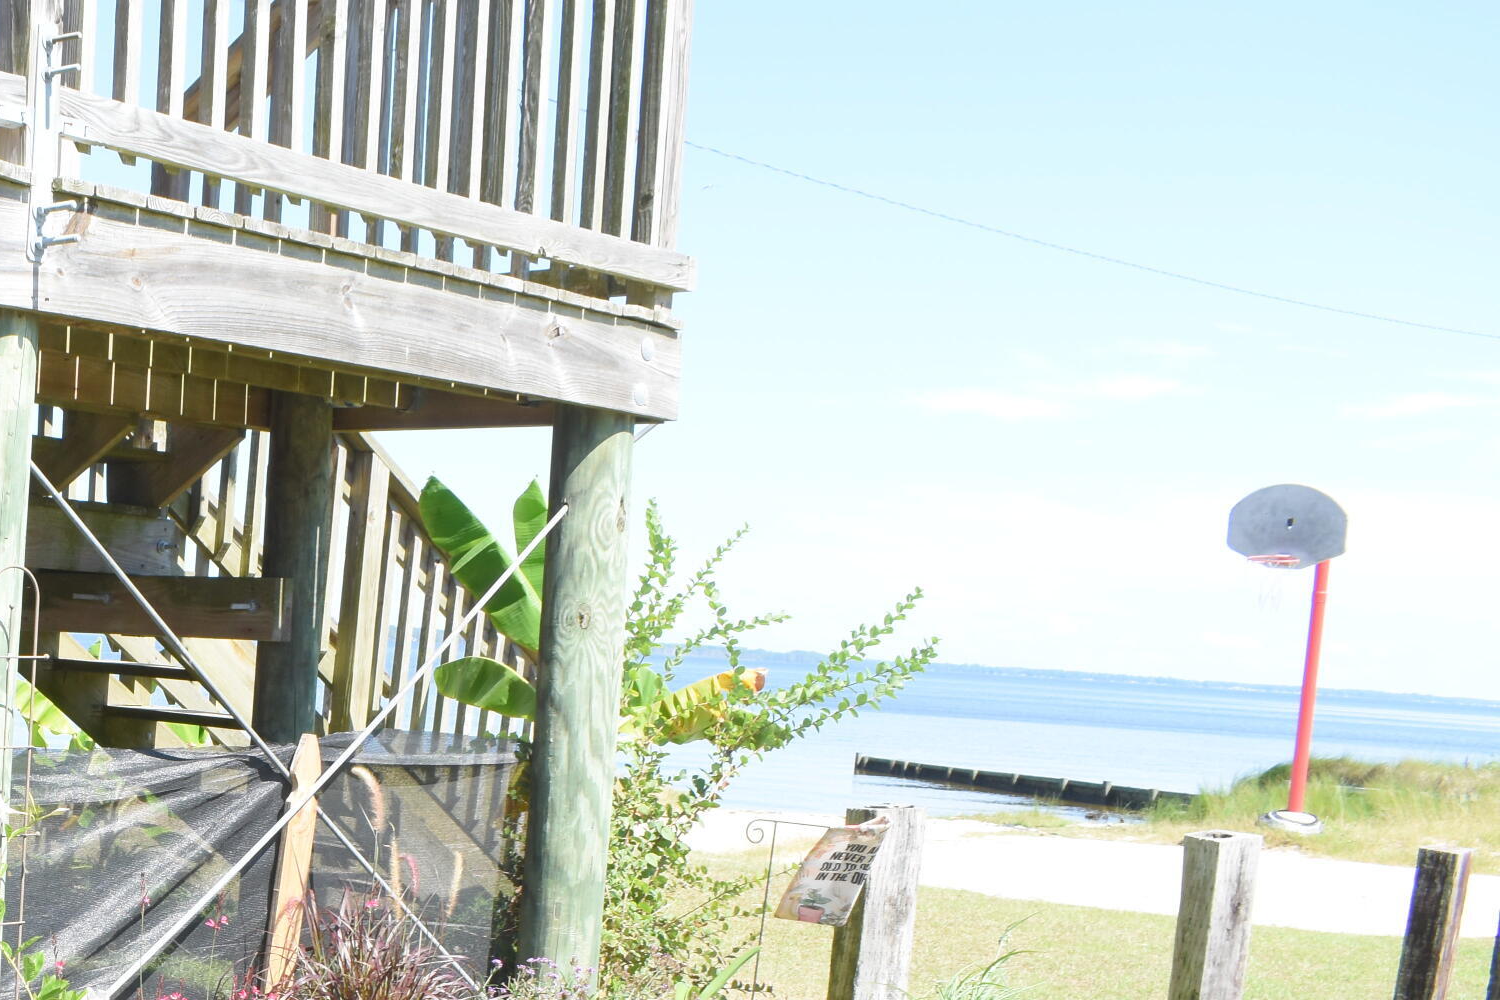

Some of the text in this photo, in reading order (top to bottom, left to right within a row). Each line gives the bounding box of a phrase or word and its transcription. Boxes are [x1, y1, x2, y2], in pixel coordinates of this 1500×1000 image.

[845, 844, 867, 853] YOU
[829, 852, 866, 863] NEVER
[820, 862, 841, 871] OLD
[843, 863, 857, 872] TO
[815, 872, 829, 881] IN
[830, 872, 850, 881] THE
